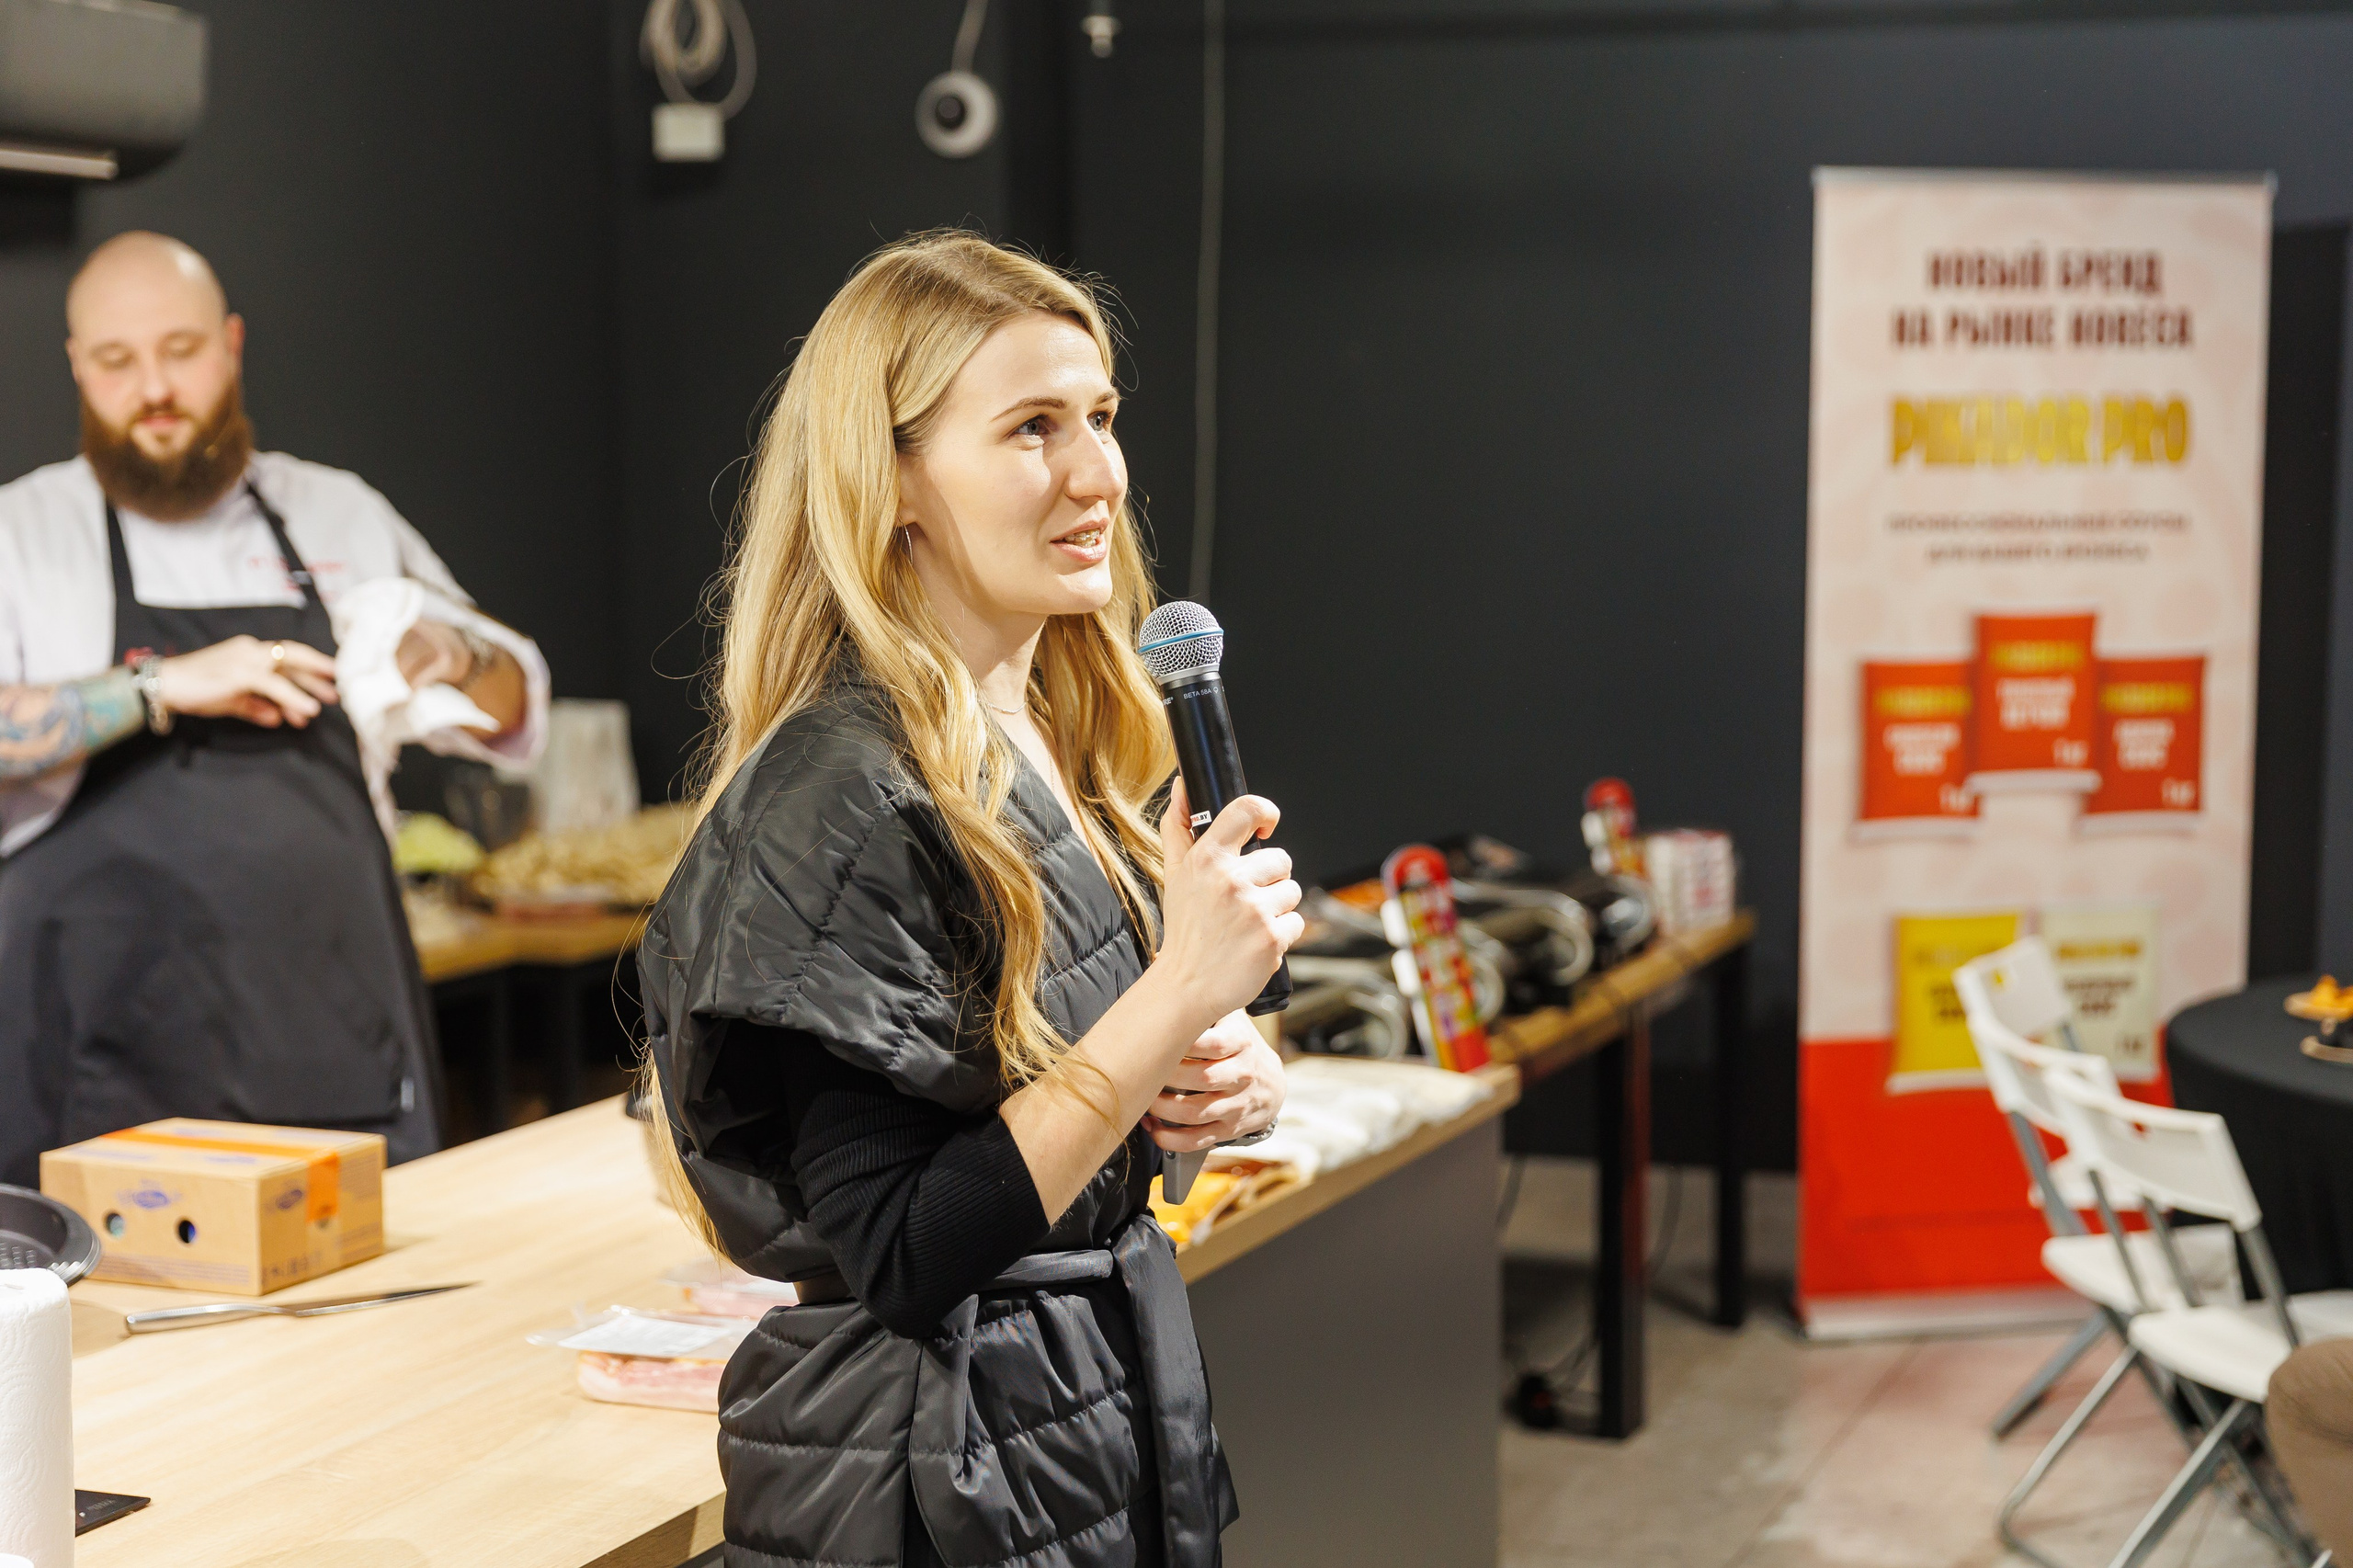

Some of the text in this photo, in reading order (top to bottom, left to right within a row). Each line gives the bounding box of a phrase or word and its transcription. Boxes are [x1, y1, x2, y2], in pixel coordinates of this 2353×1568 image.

[1928, 246, 2162, 294] НОВЫЙ БРЕНД
[1946, 310, 2056, 348] РЫНКЕ
[2100, 396, 2192, 467] PRO
[1183, 690, 1200, 699] BETA
